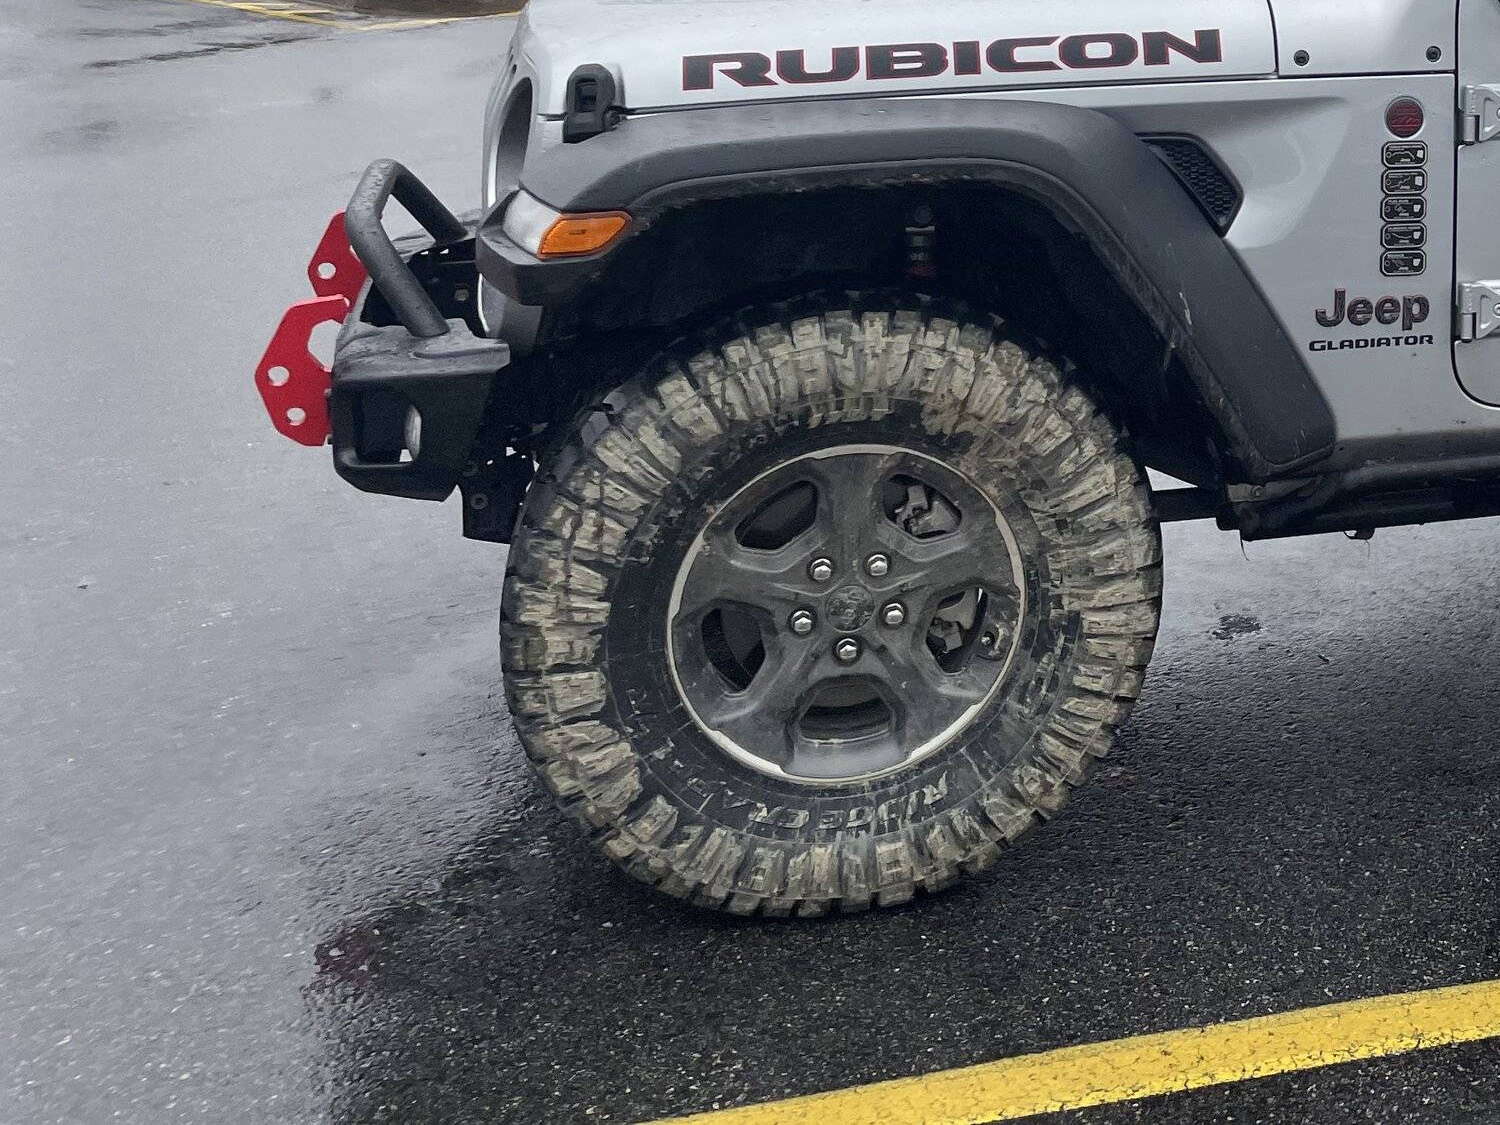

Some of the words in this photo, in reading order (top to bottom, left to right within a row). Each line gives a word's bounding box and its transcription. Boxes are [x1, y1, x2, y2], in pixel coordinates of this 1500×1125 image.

[682, 28, 1223, 91] RUBICON
[1315, 287, 1430, 331] Jeep
[1308, 334, 1434, 352] GLADIATOR
